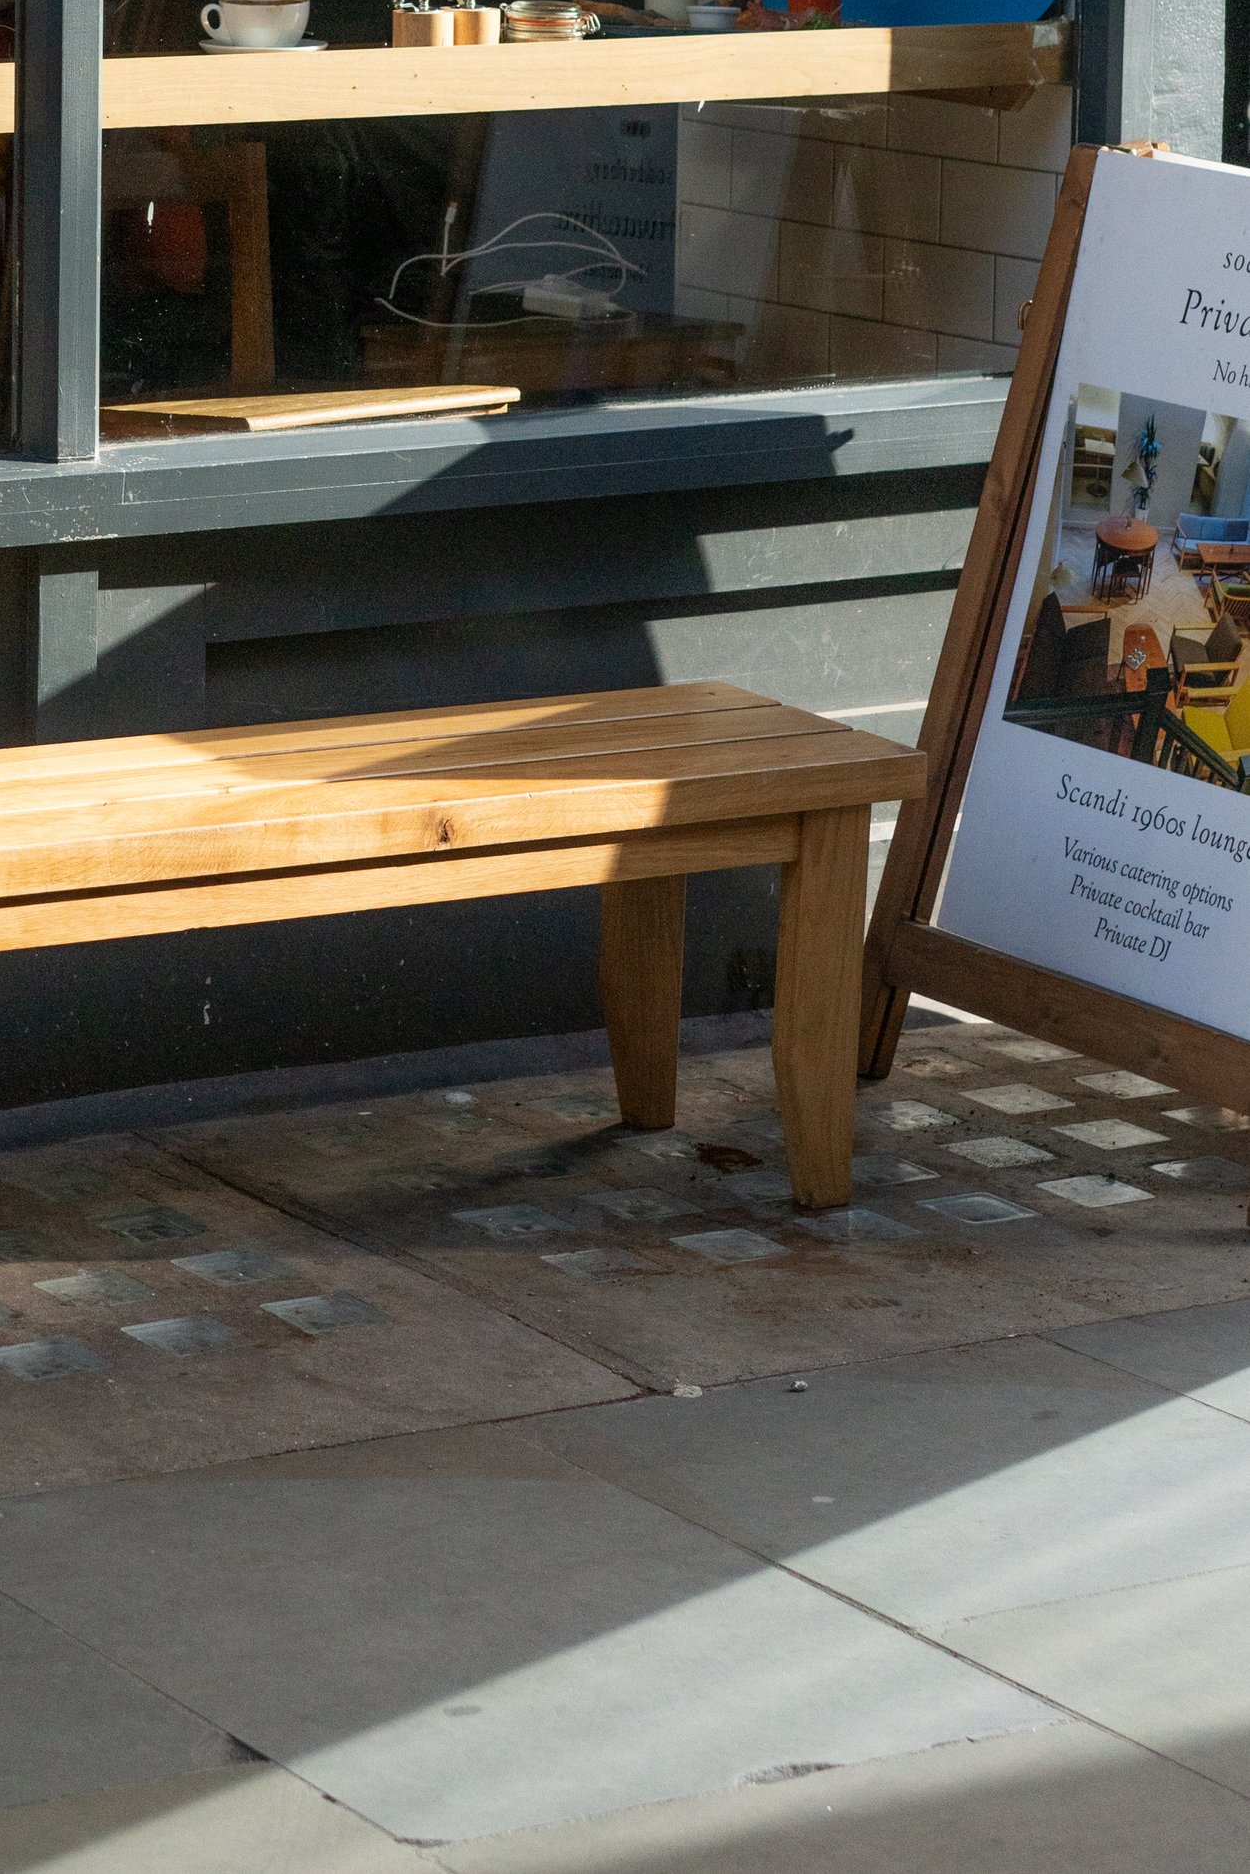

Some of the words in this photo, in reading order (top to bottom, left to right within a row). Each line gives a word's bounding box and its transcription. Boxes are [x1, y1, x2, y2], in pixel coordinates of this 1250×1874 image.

[1213, 359, 1236, 384] No
[1057, 774, 1128, 818] Scandi
[1131, 806, 1186, 837] 1960s
[1064, 836, 1119, 874] Various
[1120, 862, 1180, 899] catering
[1182, 882, 1234, 912] options
[1069, 874, 1123, 910] Private
[1124, 899, 1184, 930] cocktail
[1183, 911, 1210, 939] bar
[1094, 917, 1147, 954] Private
[1149, 936, 1172, 962] DJ
